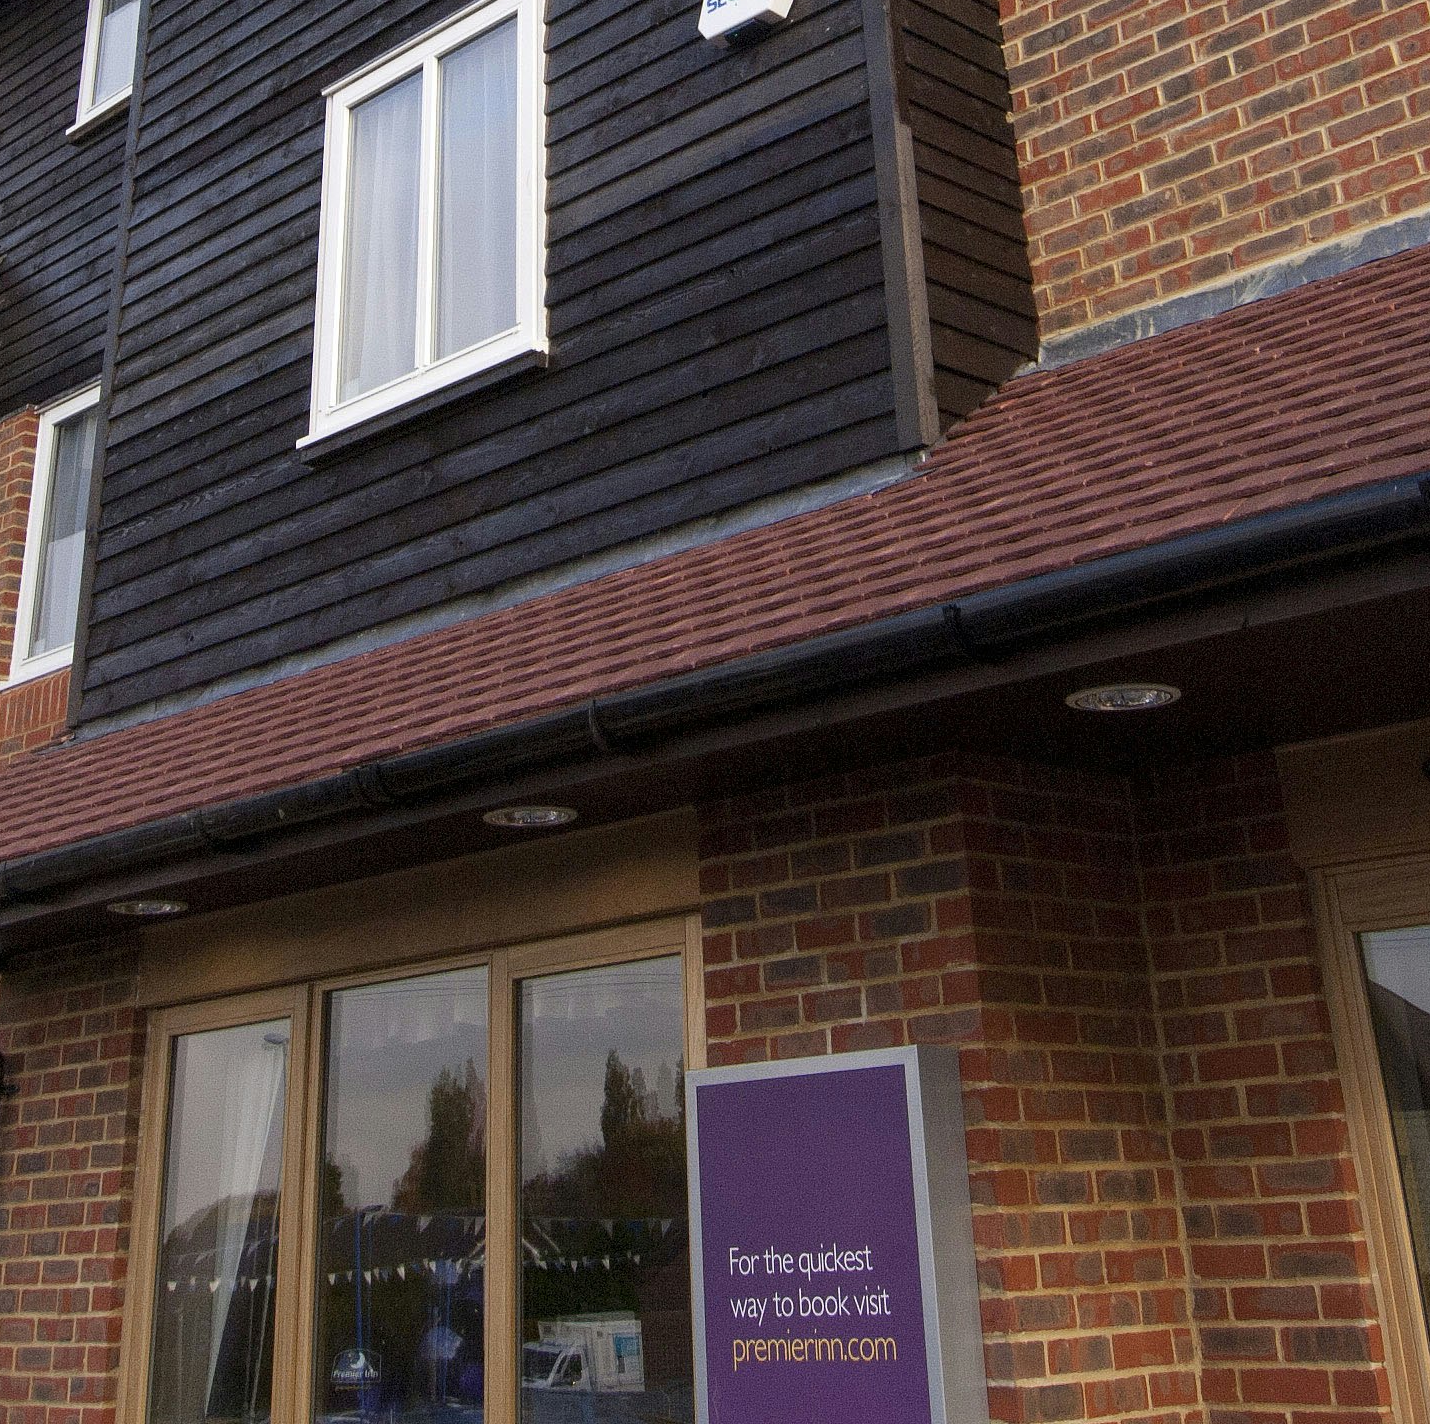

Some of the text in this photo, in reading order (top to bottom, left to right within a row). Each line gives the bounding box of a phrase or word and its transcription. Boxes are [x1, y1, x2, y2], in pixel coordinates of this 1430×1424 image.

[729, 1243, 874, 1282] For the quickest
[729, 1285, 892, 1327] way to book visit
[732, 1328, 899, 1372] premierinn.com
